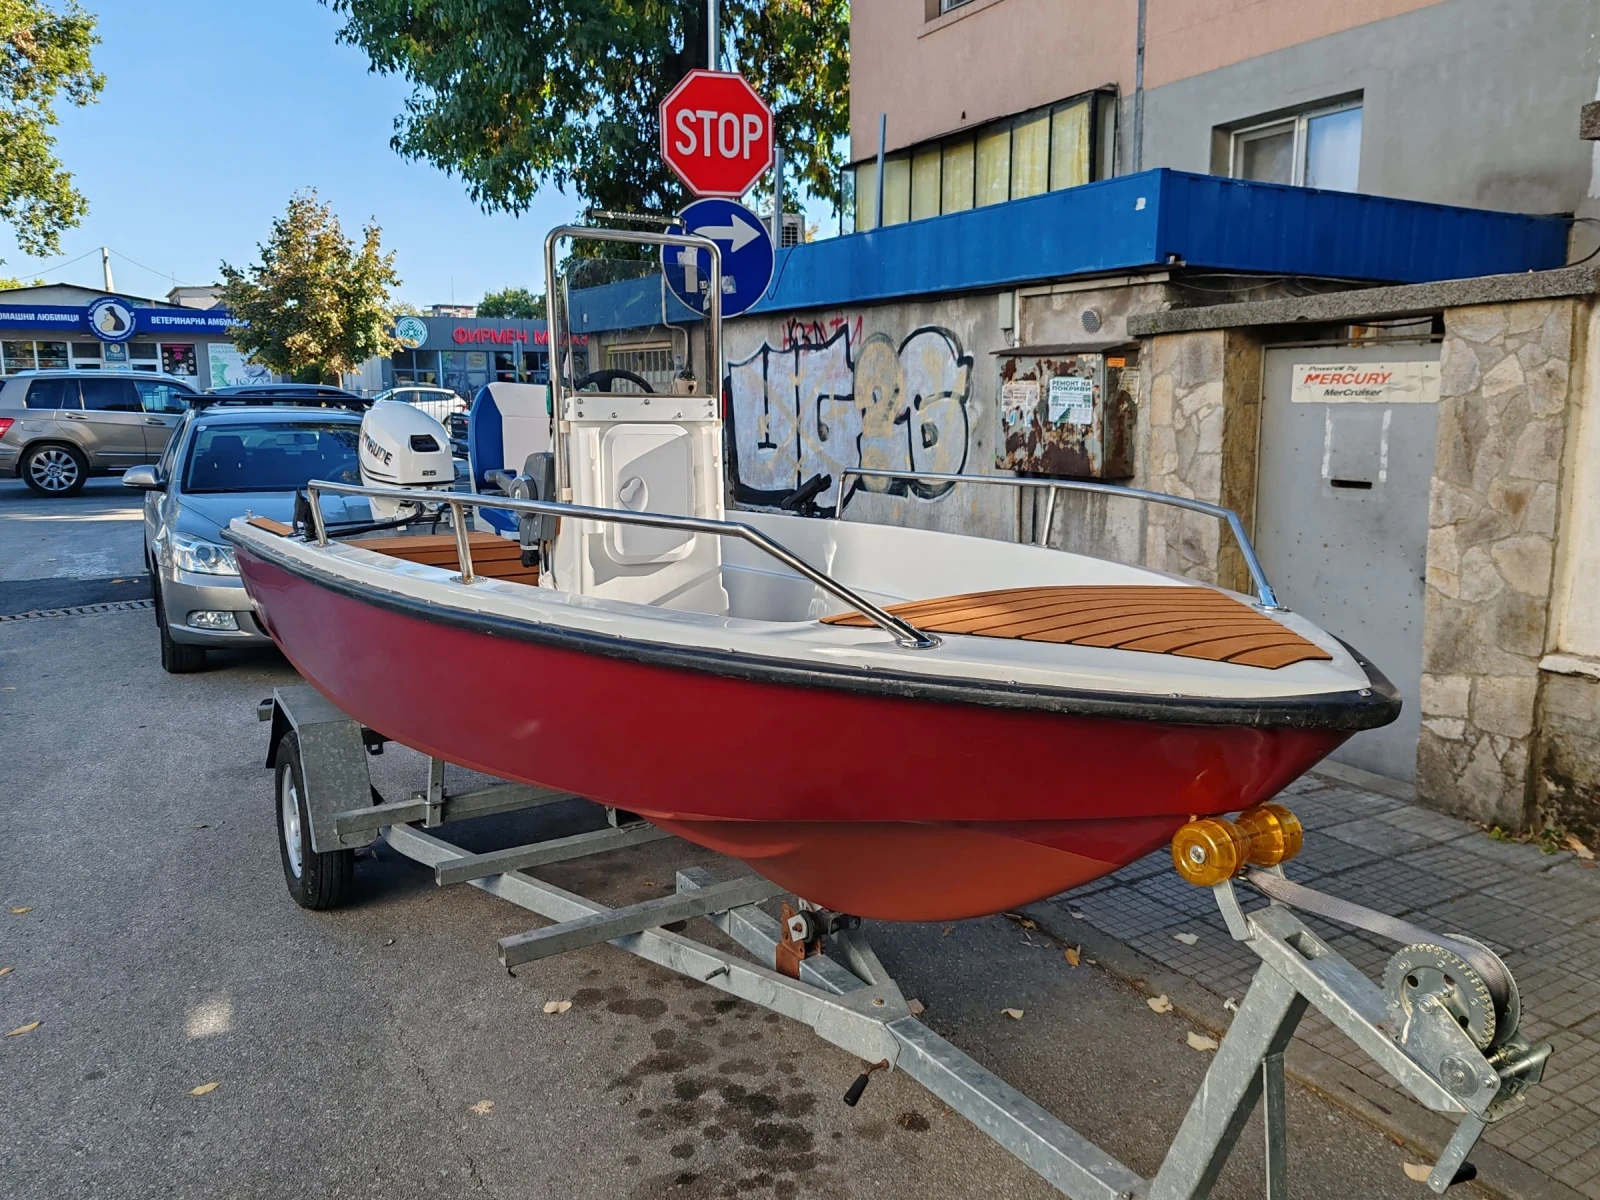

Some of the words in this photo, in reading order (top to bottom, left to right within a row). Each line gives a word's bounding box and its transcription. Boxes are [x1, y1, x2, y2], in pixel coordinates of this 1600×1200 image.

[675, 108, 763, 160] STOP
[37, 313, 80, 322] ЛЮБИМЦИ
[151, 316, 206, 326] ВЕТЕРИНАРНА
[453, 327, 527, 345] ФИРМЕН
[1304, 372, 1392, 385] MERCURY
[1324, 388, 1382, 396] MerCruiser
